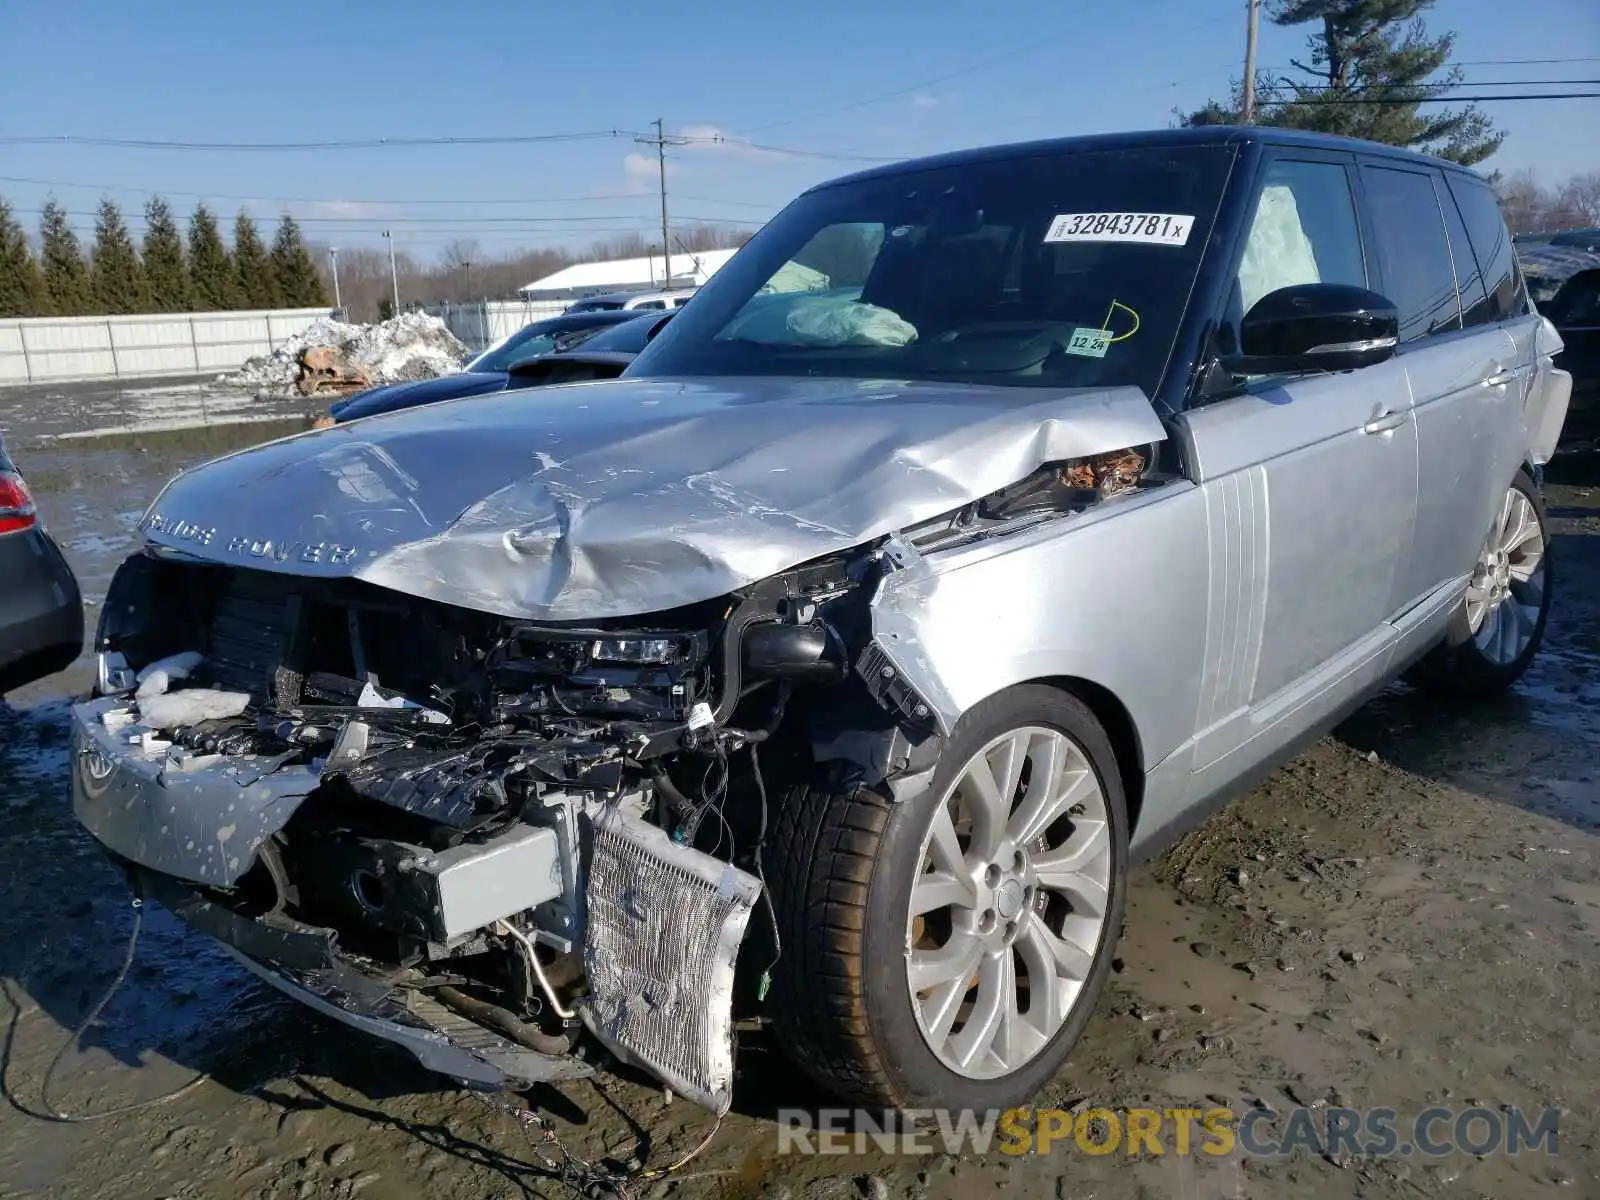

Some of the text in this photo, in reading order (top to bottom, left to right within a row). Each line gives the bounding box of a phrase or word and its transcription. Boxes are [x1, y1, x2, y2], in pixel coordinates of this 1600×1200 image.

[1067, 213, 1172, 237] 32843781
[1072, 336, 1089, 348] 12
[227, 537, 358, 565] ROVER
